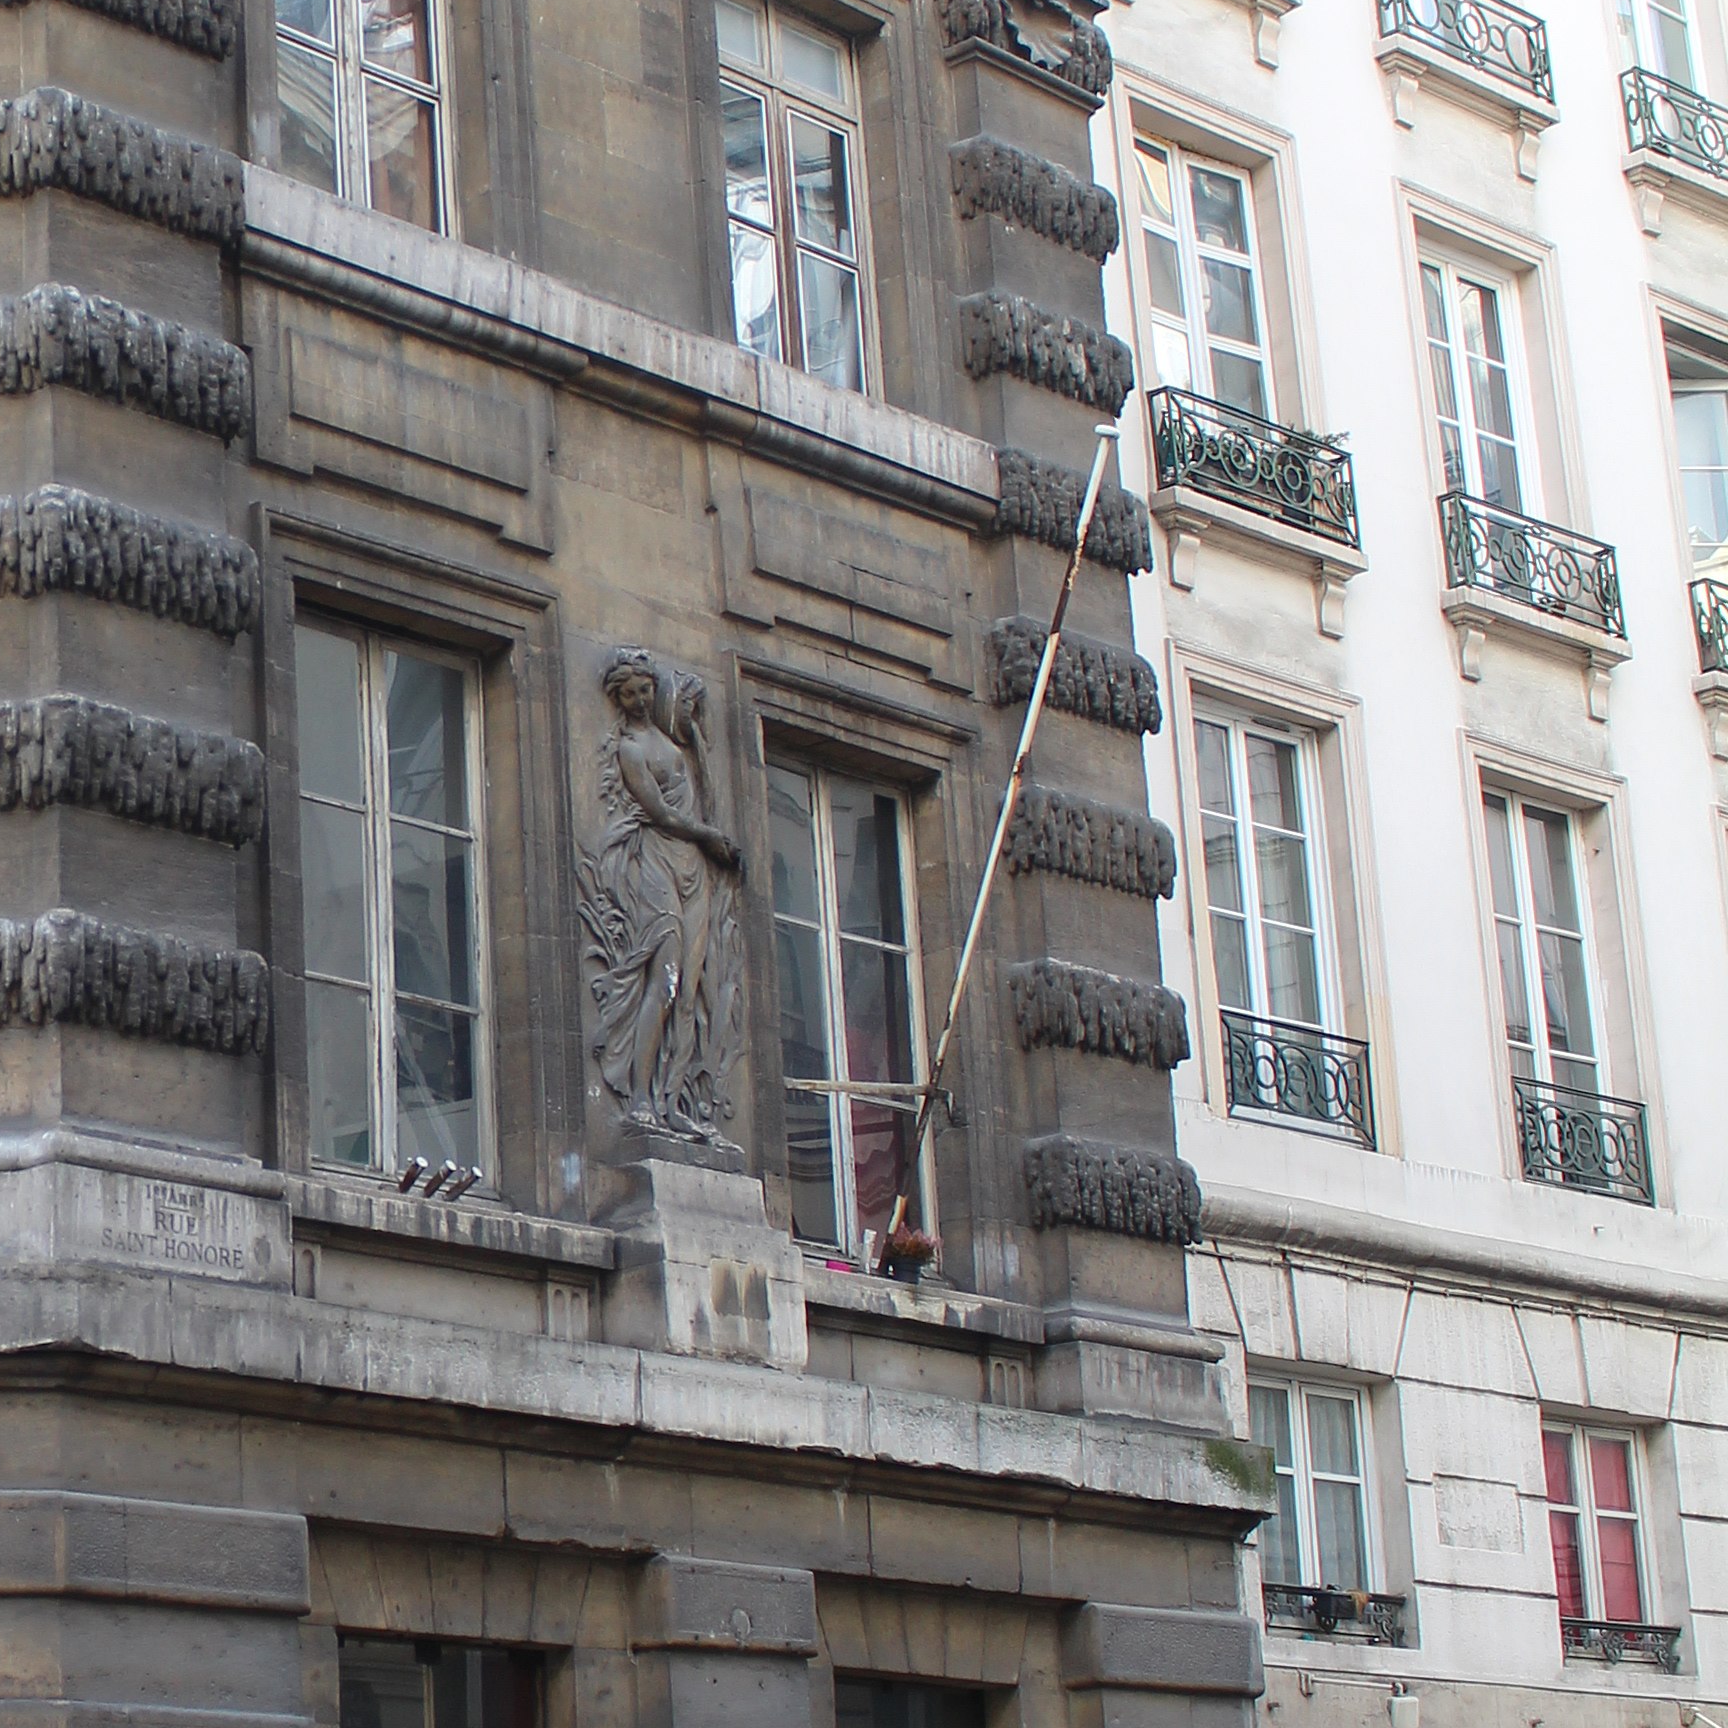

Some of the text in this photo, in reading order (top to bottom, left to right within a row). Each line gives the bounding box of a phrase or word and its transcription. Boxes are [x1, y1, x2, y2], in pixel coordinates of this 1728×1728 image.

[154, 1211, 199, 1236] RUE
[101, 1228, 245, 1270] SAINT HONORÉ
